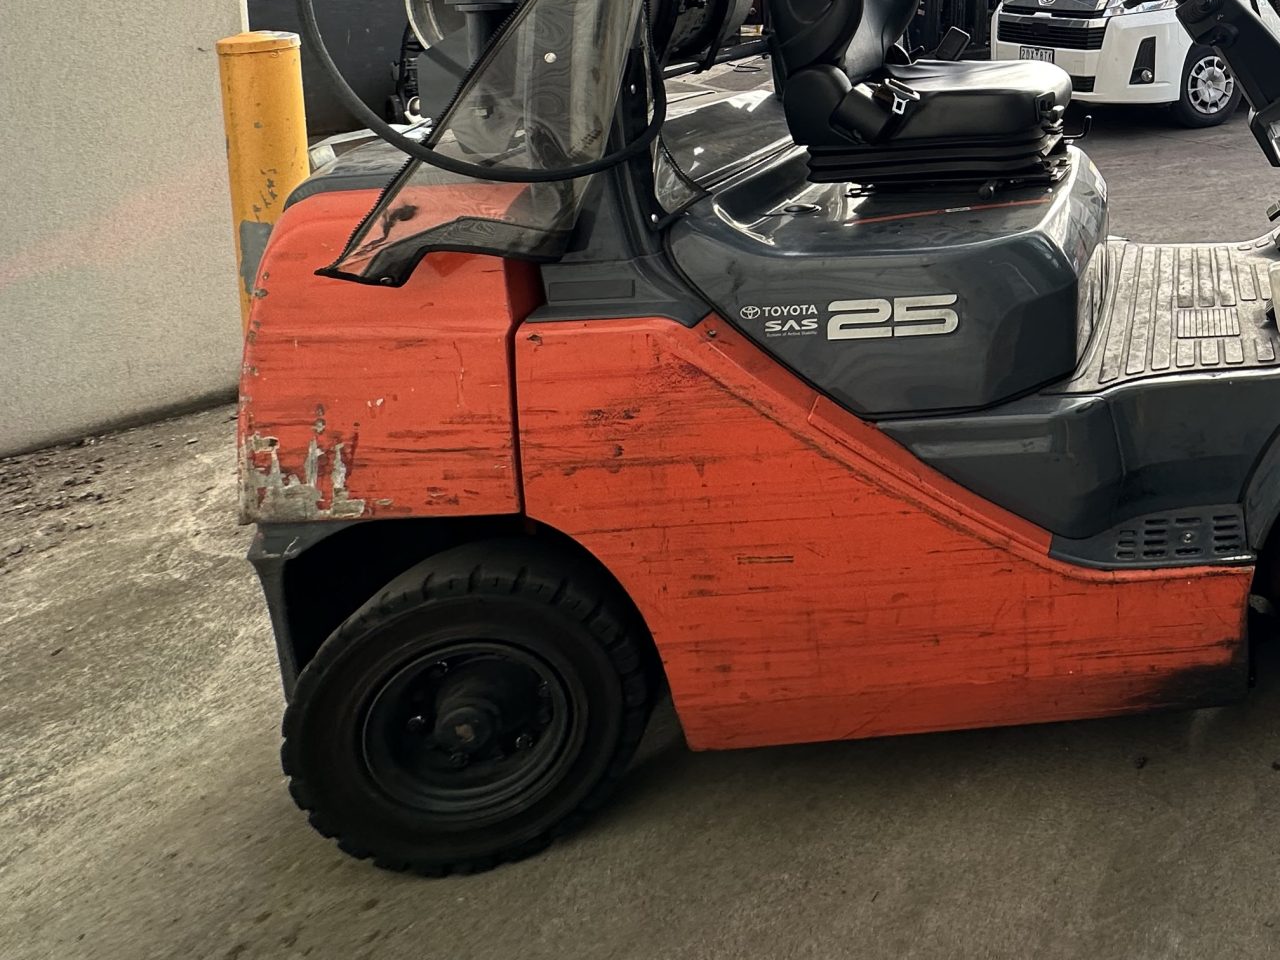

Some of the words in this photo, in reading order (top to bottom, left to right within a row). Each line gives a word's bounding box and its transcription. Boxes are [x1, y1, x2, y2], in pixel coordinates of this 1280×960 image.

[762, 304, 818, 317] TOYOTA
[827, 294, 959, 340] 25
[765, 318, 818, 332] SAS
